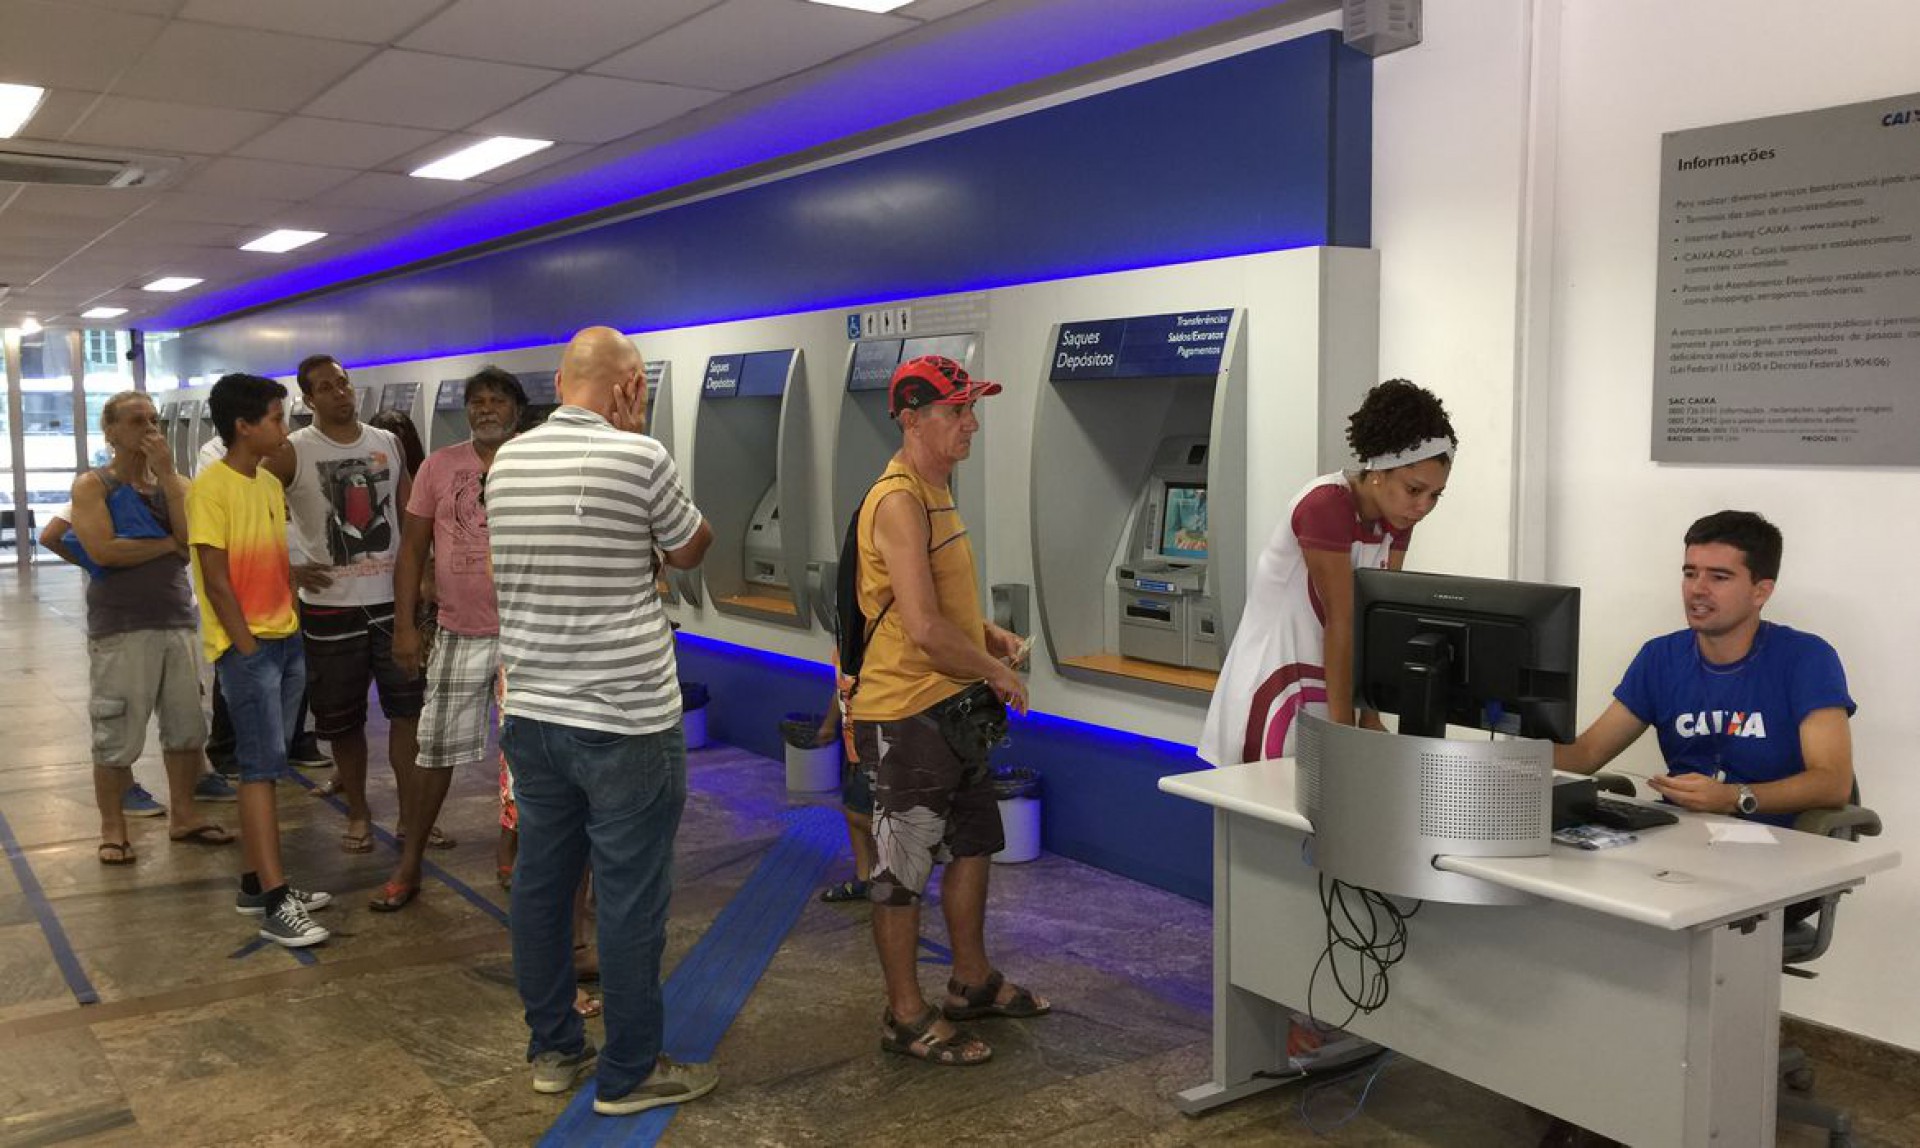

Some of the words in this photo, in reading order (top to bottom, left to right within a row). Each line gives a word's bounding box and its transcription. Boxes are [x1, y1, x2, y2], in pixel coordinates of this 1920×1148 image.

[1677, 146, 1776, 171] Informações
[1757, 225, 1790, 236] CAIXA
[1684, 250, 1714, 261] CAIXA
[1717, 247, 1743, 259] AQUI
[1752, 246, 1777, 255] Casas
[1671, 328, 1678, 336] A
[1680, 327, 1712, 336] entrada
[1062, 330, 1100, 350] Saques
[1710, 340, 1729, 349] para
[1849, 332, 1861, 341] de
[1177, 345, 1221, 358] Pagamentos
[1740, 351, 1751, 359] ou
[1753, 350, 1763, 358] de
[1056, 351, 1115, 372] Depósitos
[1687, 363, 1717, 373] Federal
[1770, 361, 1808, 370] Decreto
[1809, 358, 1843, 368] Federal
[1688, 397, 1717, 405] CAIXA
